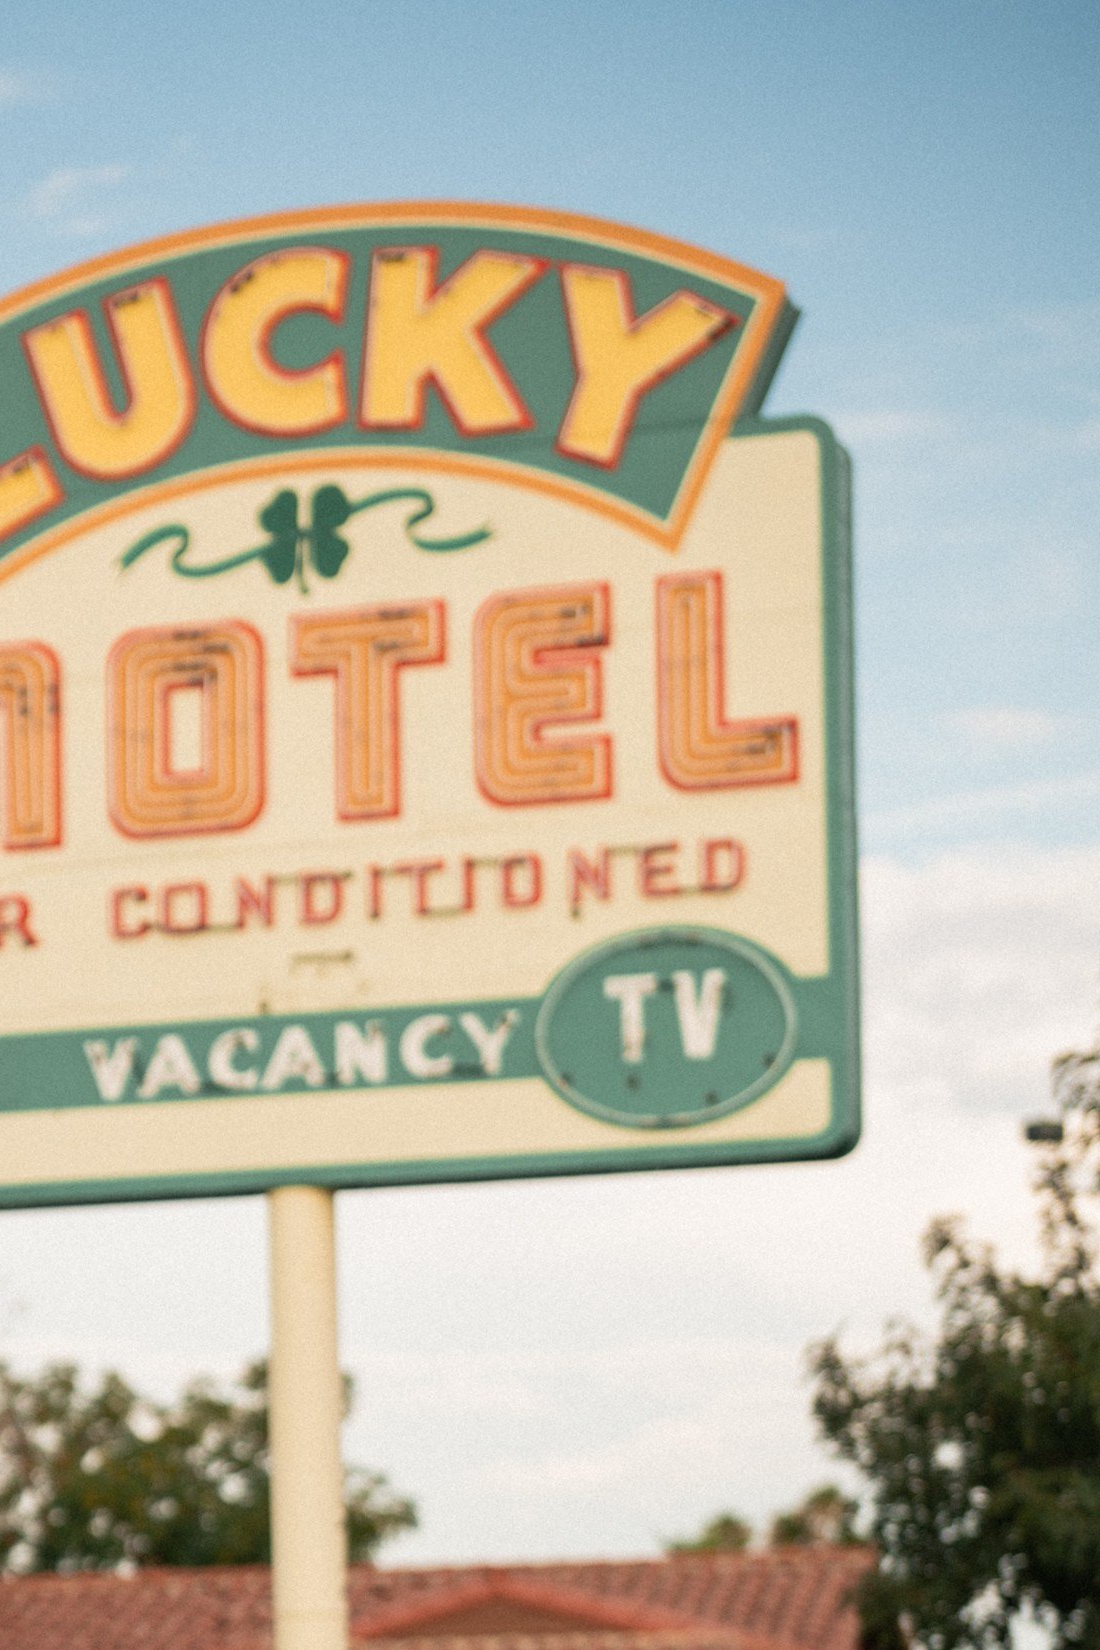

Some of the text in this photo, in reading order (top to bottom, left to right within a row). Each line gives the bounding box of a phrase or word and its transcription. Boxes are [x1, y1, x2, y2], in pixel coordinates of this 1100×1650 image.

[111, 839, 747, 941] CONDITIONED
[82, 1008, 521, 1102] VACANCY
[602, 968, 726, 1063] TV
